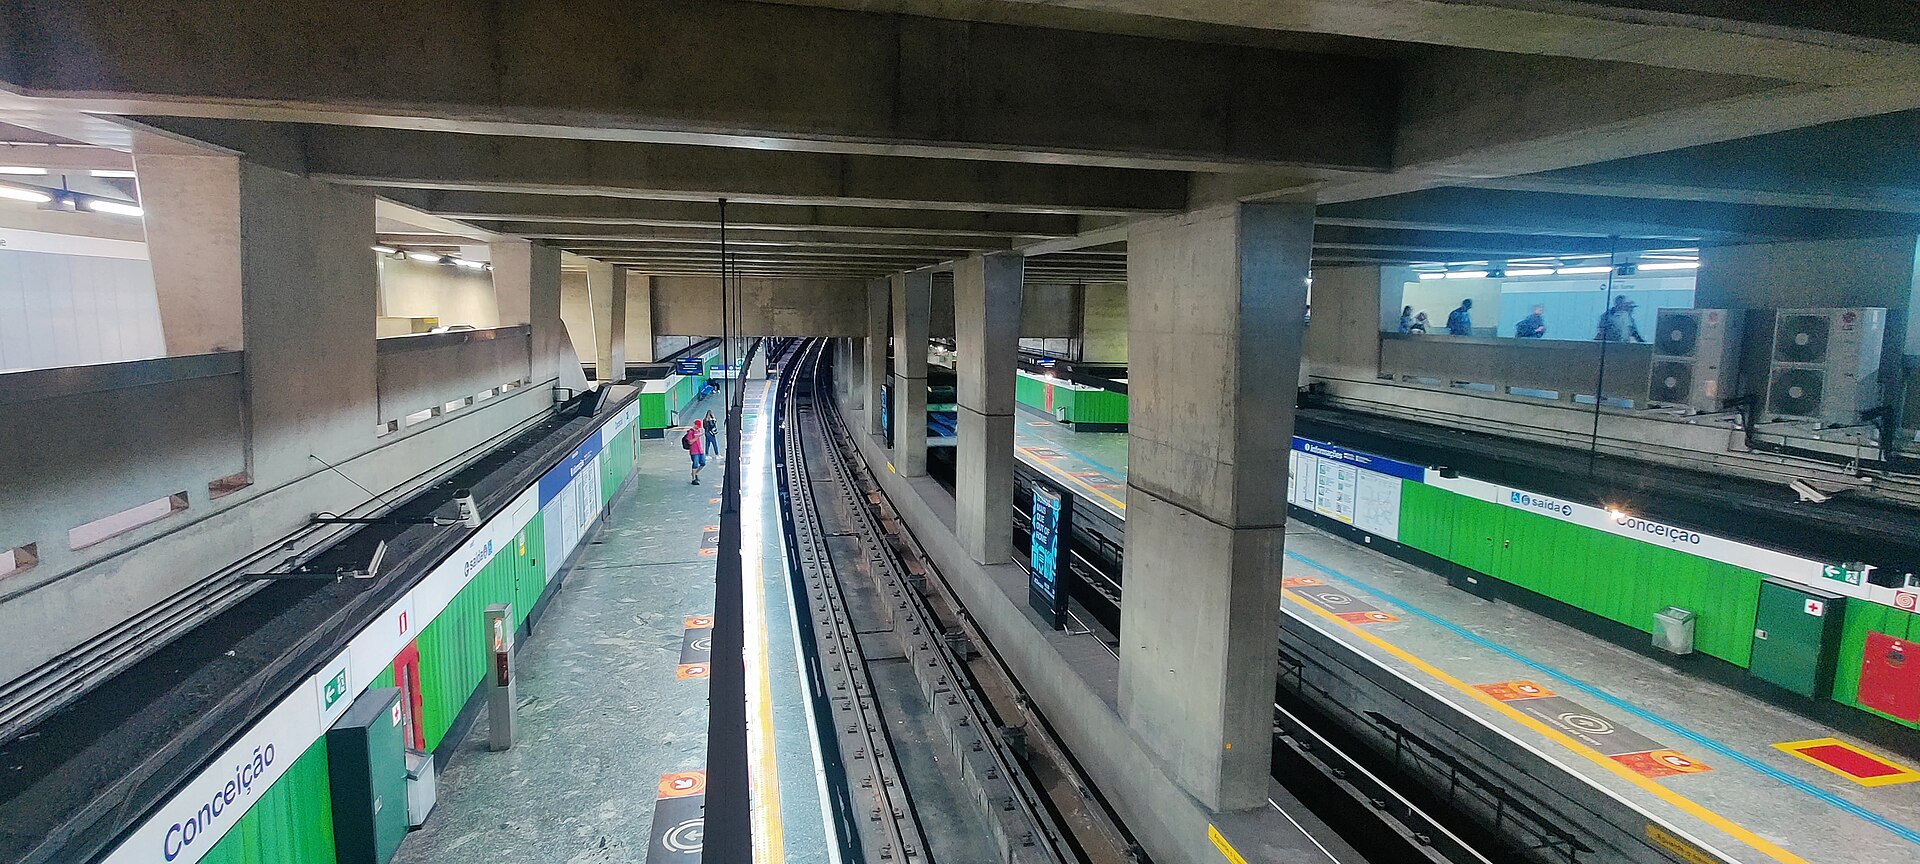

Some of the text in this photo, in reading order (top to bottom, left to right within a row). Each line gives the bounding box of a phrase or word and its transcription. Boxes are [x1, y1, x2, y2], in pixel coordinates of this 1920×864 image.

[1532, 498, 1561, 512] saída
[1036, 522, 1051, 536] OUT OF
[164, 743, 275, 863] Conceição
